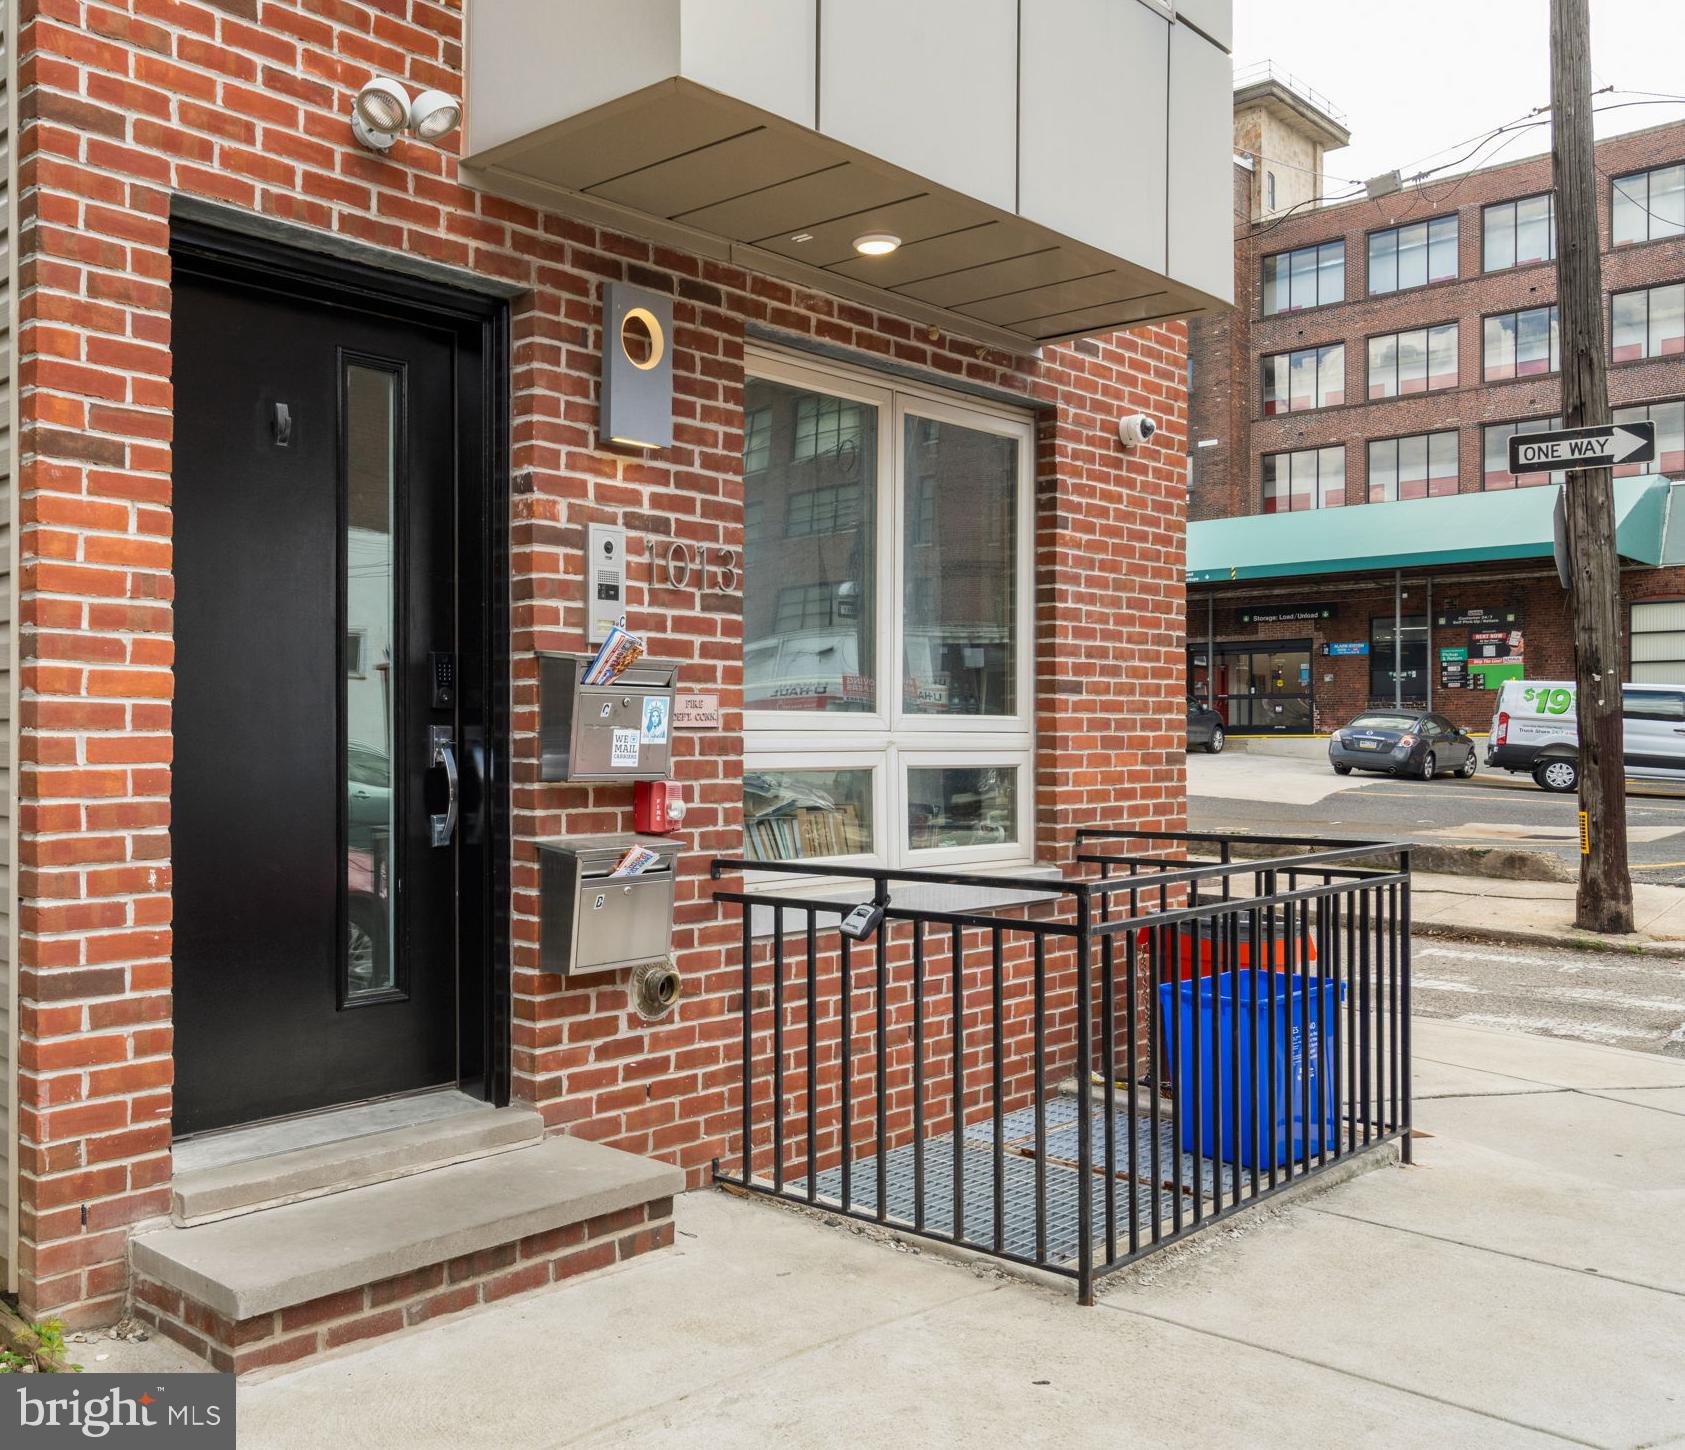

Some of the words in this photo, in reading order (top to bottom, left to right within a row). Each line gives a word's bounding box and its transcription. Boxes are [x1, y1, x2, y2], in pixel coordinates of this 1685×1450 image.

[1524, 443, 1562, 461] ONE
[1569, 438, 1609, 457] WAY
[647, 541, 737, 592] 1013
[619, 615, 626, 628] C
[685, 699, 704, 709] FIRE
[615, 734, 629, 744] WE
[614, 744, 637, 753] MAIL
